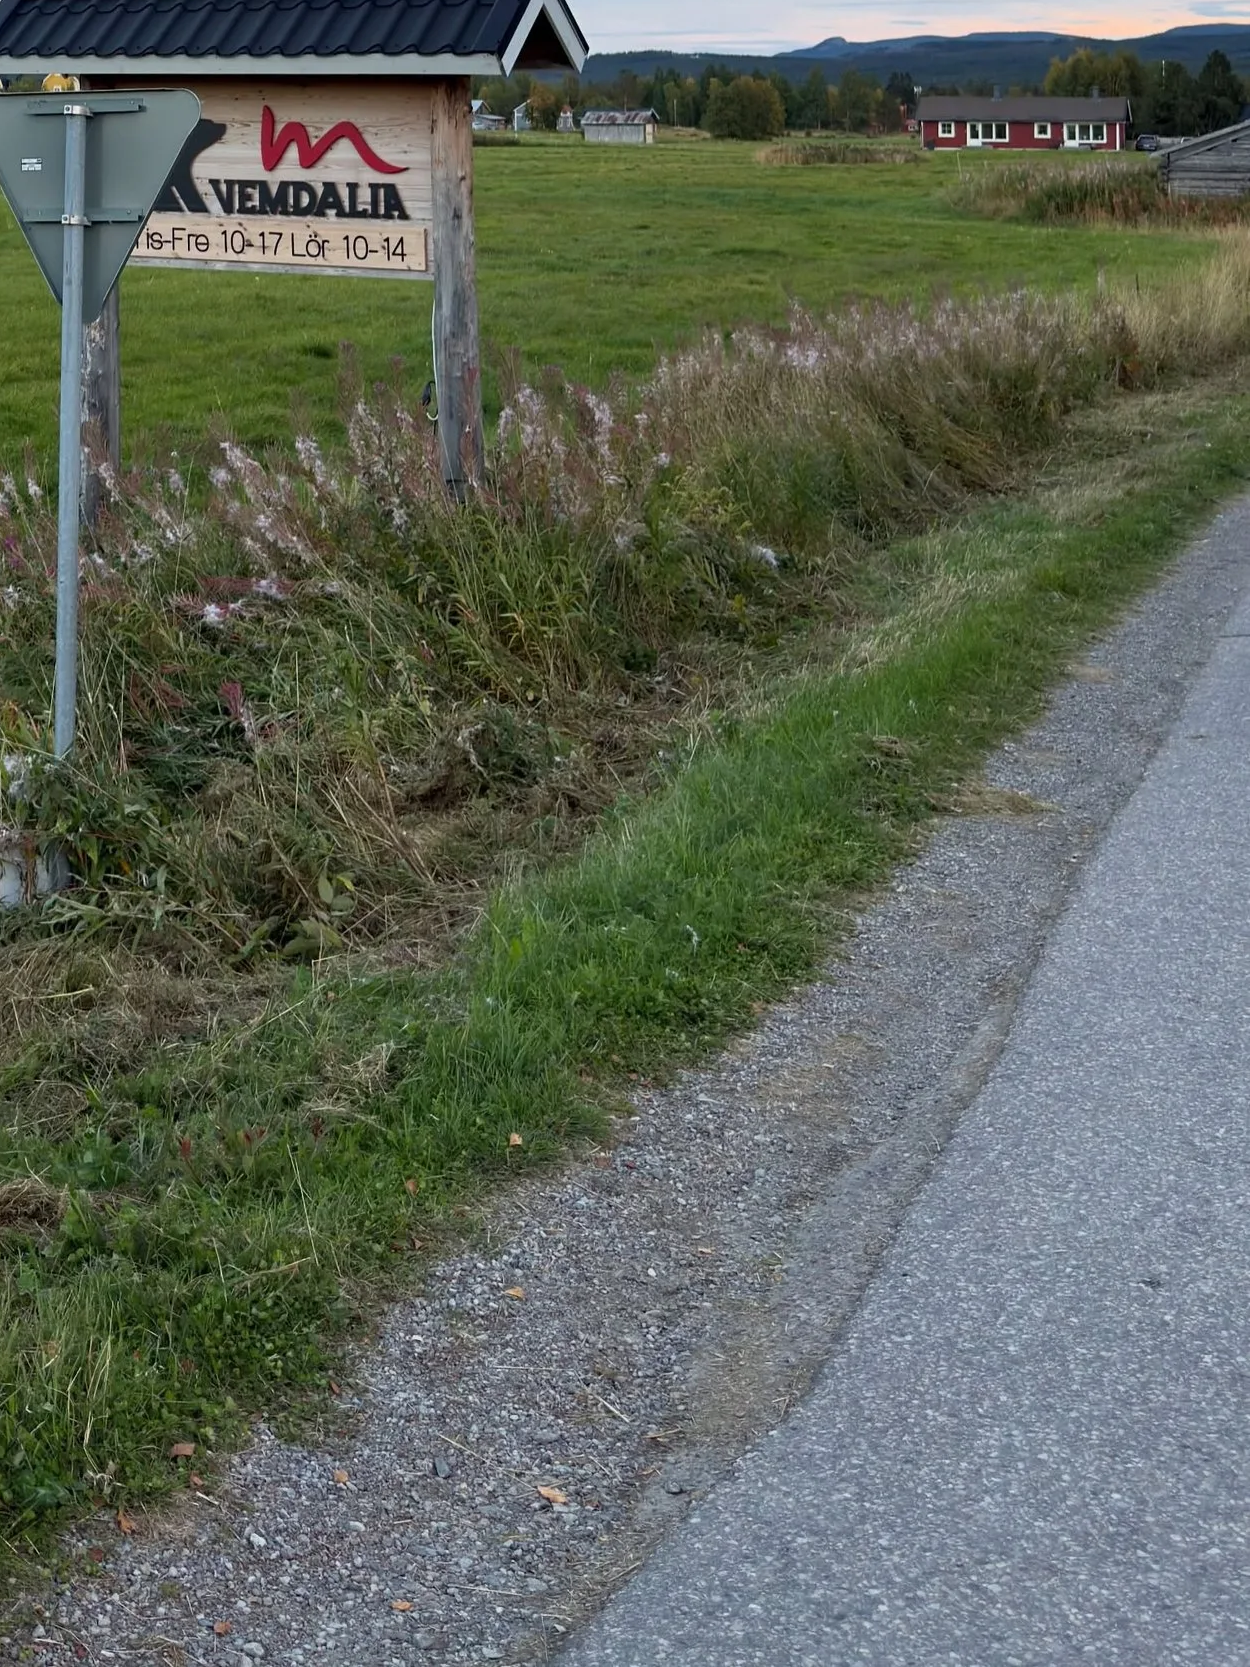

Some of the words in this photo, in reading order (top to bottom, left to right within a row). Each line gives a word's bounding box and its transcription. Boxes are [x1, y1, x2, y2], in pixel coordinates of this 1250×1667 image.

[208, 178, 410, 220] VEMDALIA
[221, 230, 283, 256] 10-17
[291, 233, 330, 259] Lör
[342, 235, 407, 262] 10-14
